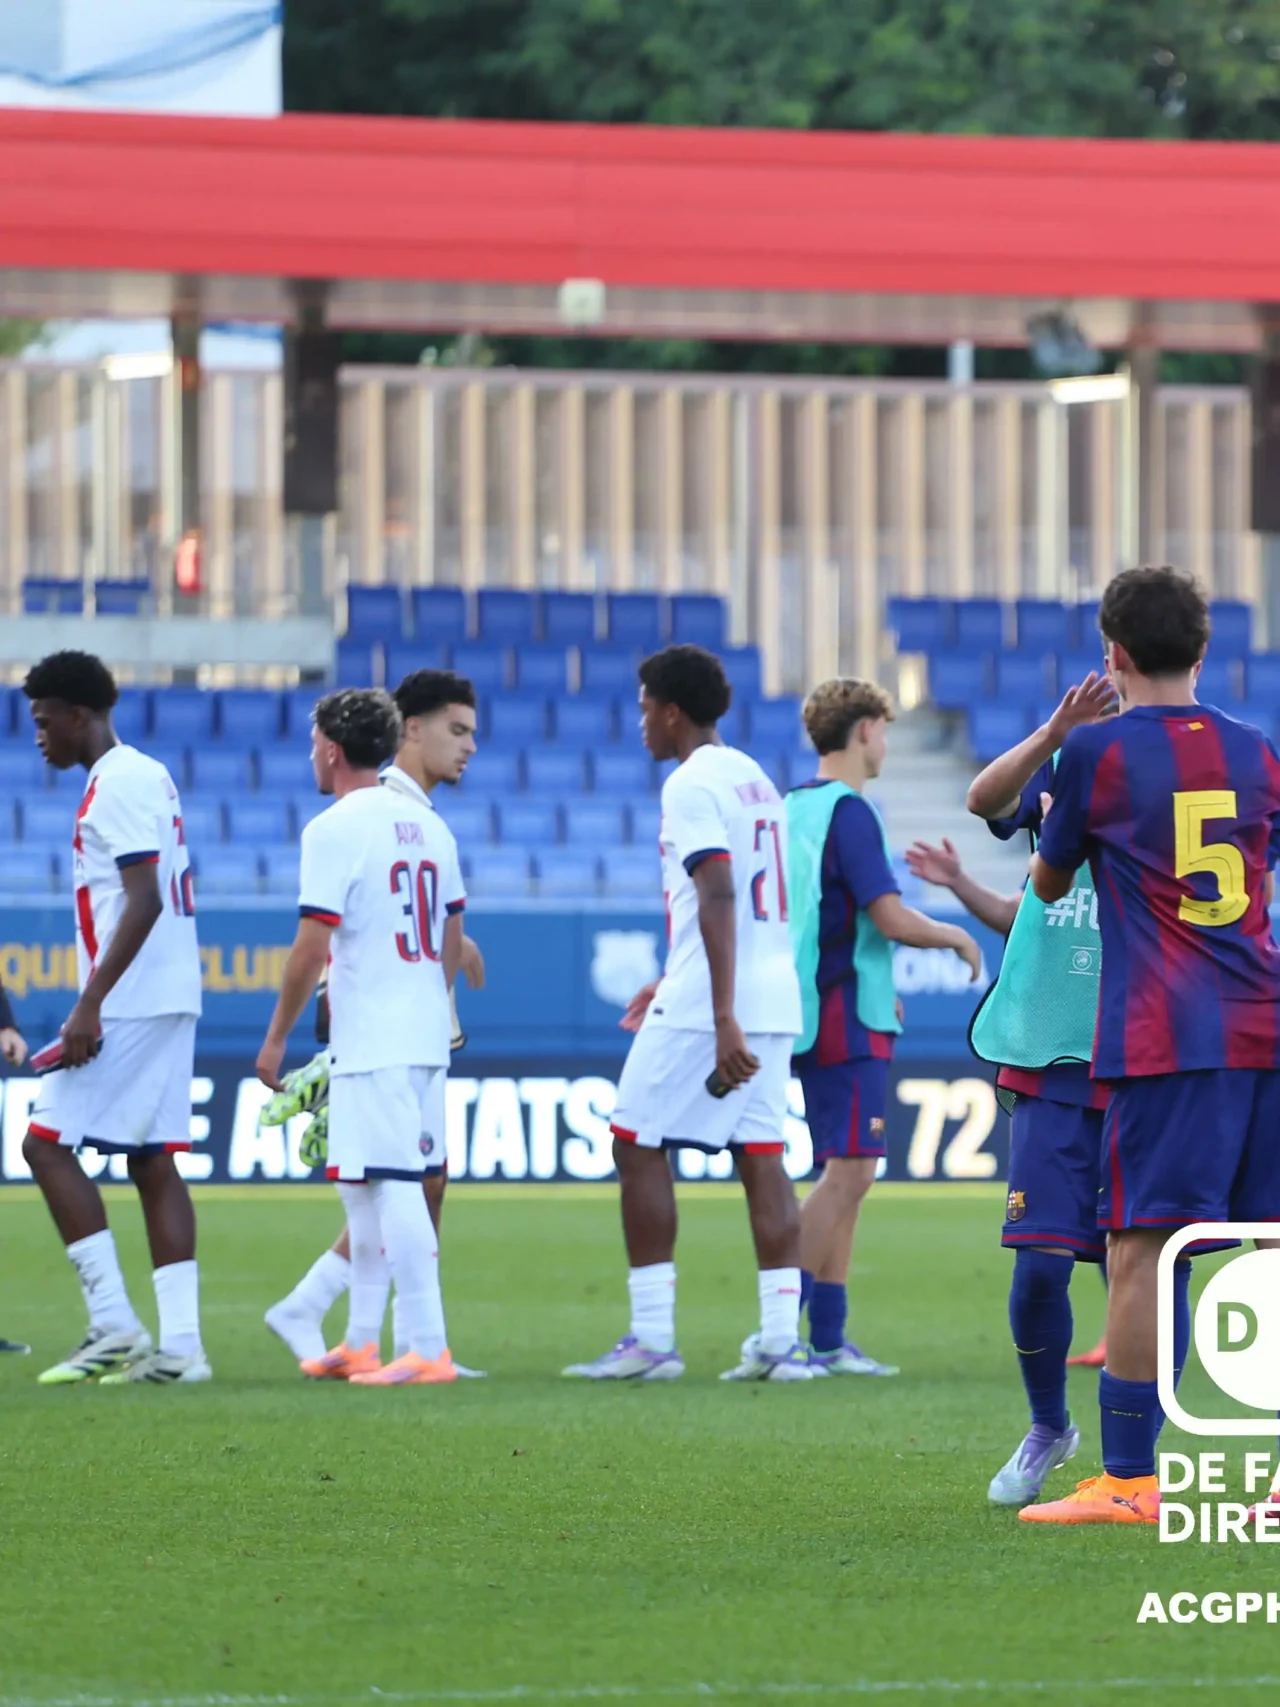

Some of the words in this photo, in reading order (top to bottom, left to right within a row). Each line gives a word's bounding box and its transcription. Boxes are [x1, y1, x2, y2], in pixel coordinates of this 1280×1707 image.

[751, 818, 788, 922] 21
[1172, 789, 1250, 927] 5
[390, 859, 443, 963] 30
[898, 1078, 998, 1181] 72
